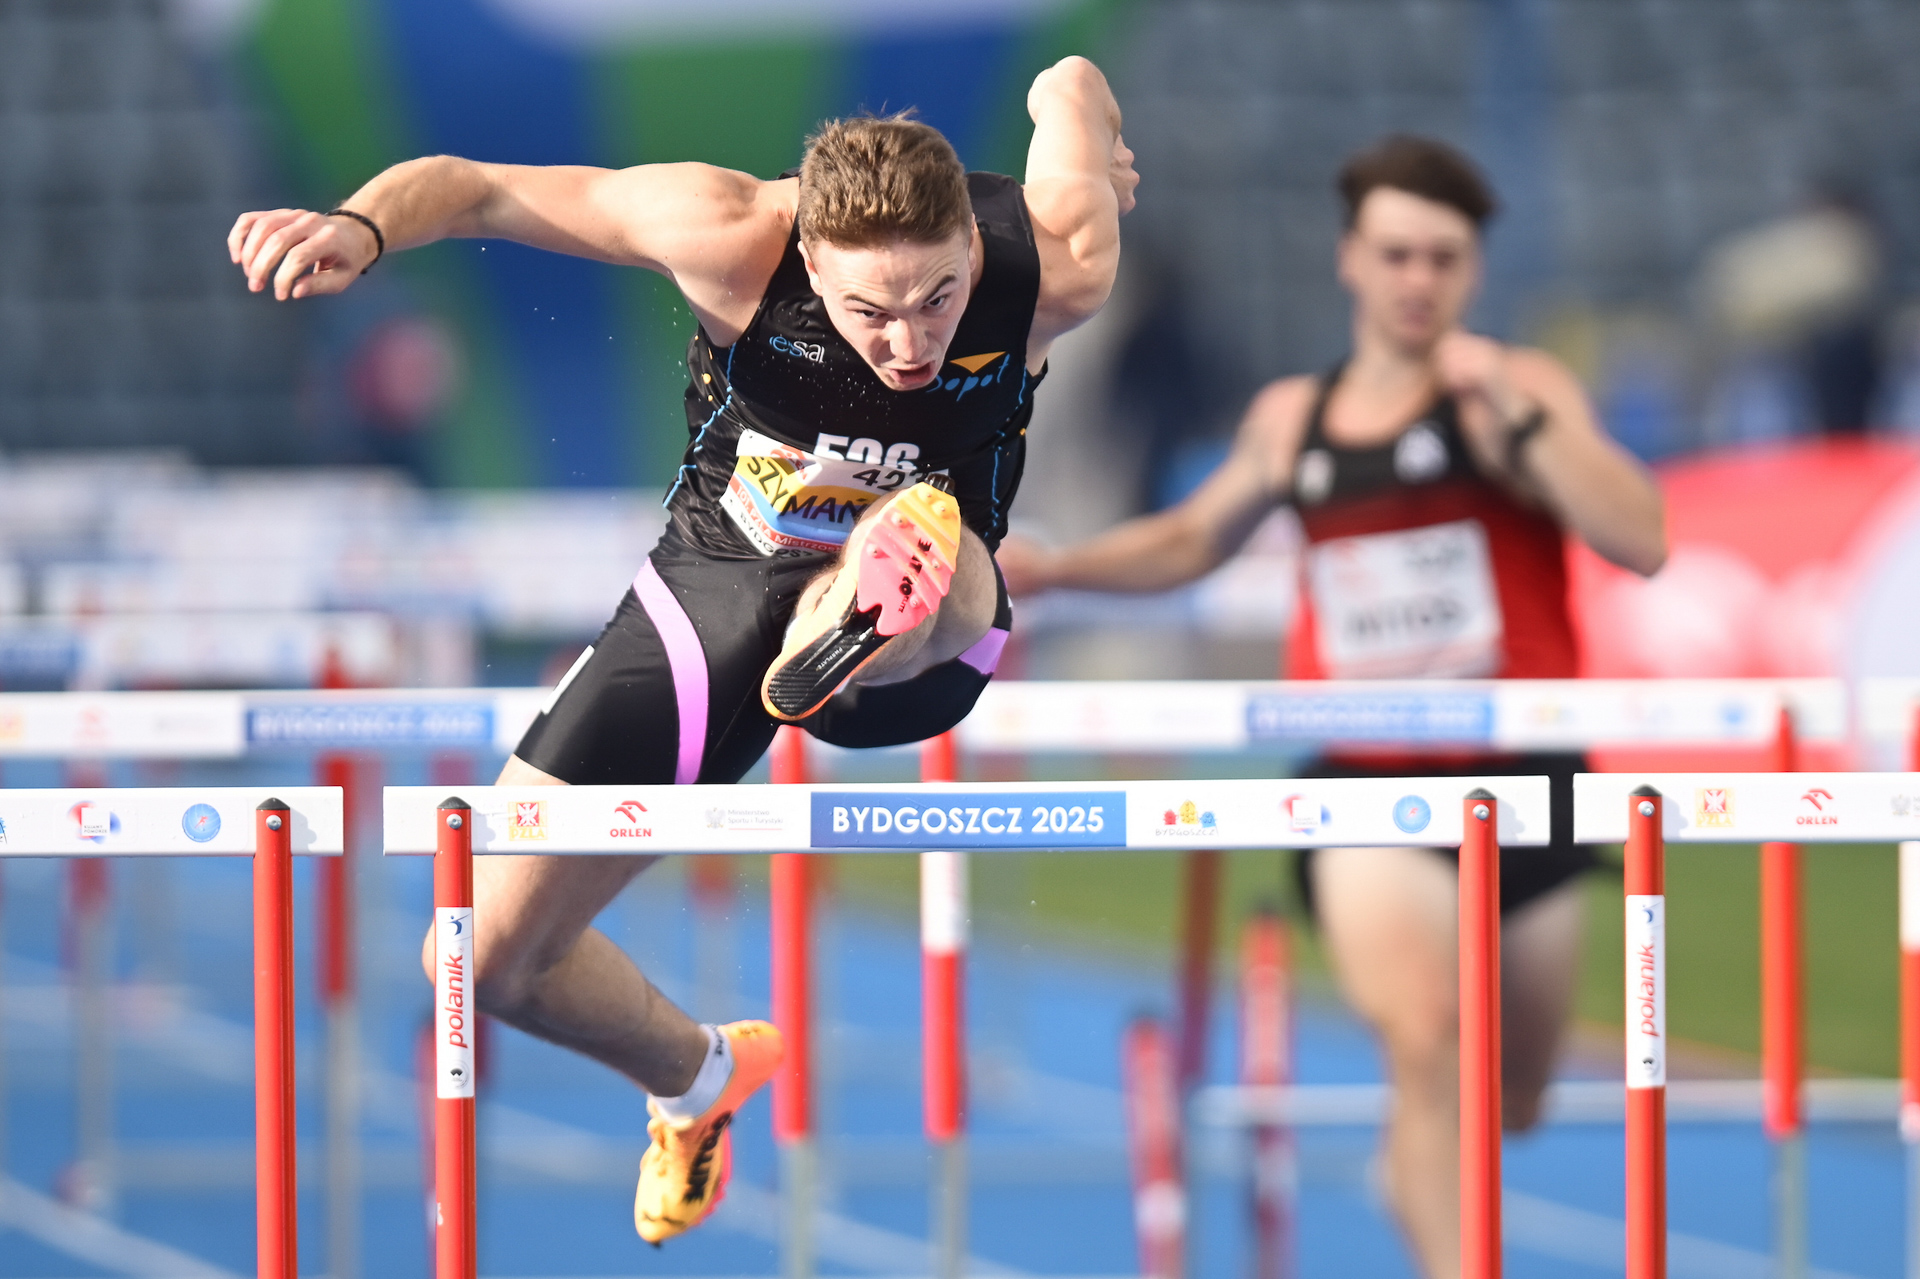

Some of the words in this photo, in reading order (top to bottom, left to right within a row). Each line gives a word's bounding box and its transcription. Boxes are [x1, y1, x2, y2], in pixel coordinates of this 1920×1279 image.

[832, 806, 1022, 833] BYDGOSZCZ
[1031, 806, 1104, 832] 2025
[1796, 815, 1838, 825] ORLEN
[510, 827, 545, 839] PZLA
[609, 828, 652, 838] ORLEN
[1155, 828, 1216, 837] BYDGOSZCZ
[1637, 943, 1660, 1038] polanik
[444, 953, 468, 1049] polanik
